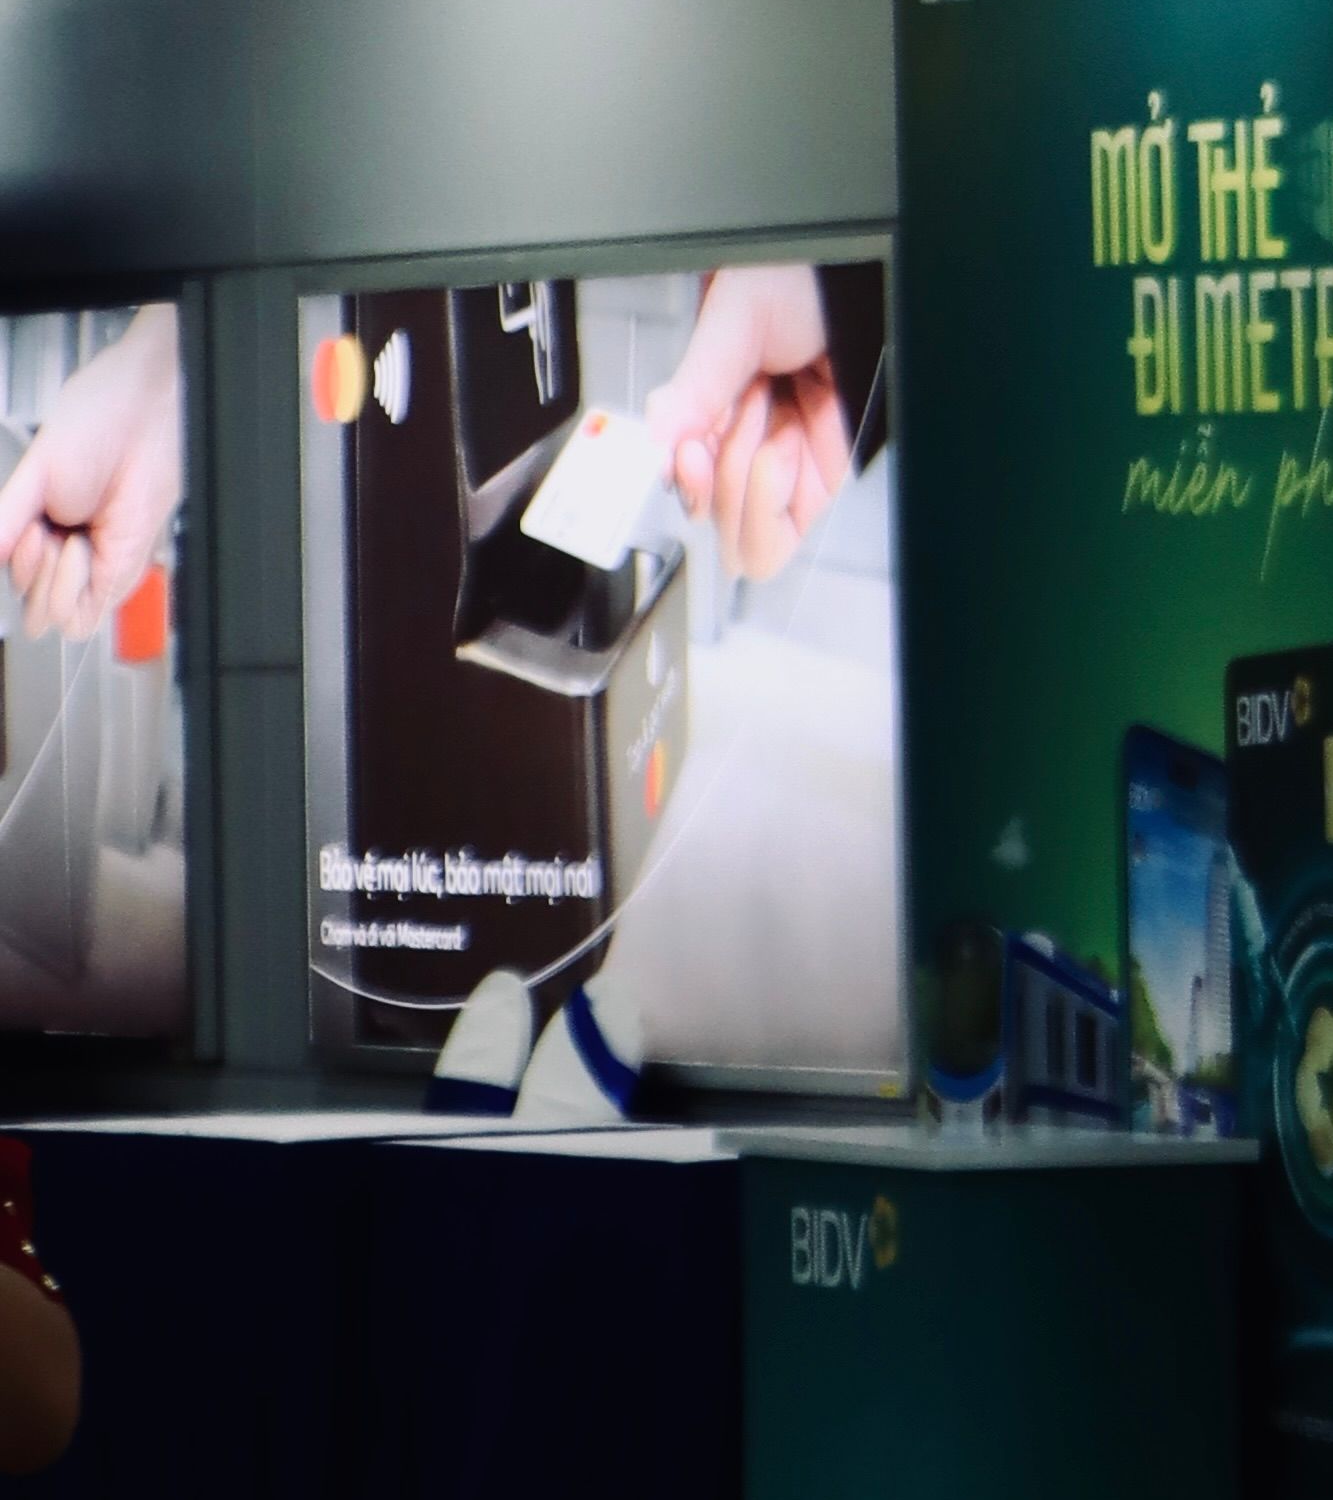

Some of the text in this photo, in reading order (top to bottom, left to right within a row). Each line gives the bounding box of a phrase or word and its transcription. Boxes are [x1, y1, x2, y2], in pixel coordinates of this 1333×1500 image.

[1090, 80, 1288, 267] MỞ THẺ
[1127, 273, 1182, 416] ĐI
[1235, 689, 1293, 748] BIDV
[791, 1206, 869, 1291] BIDV
